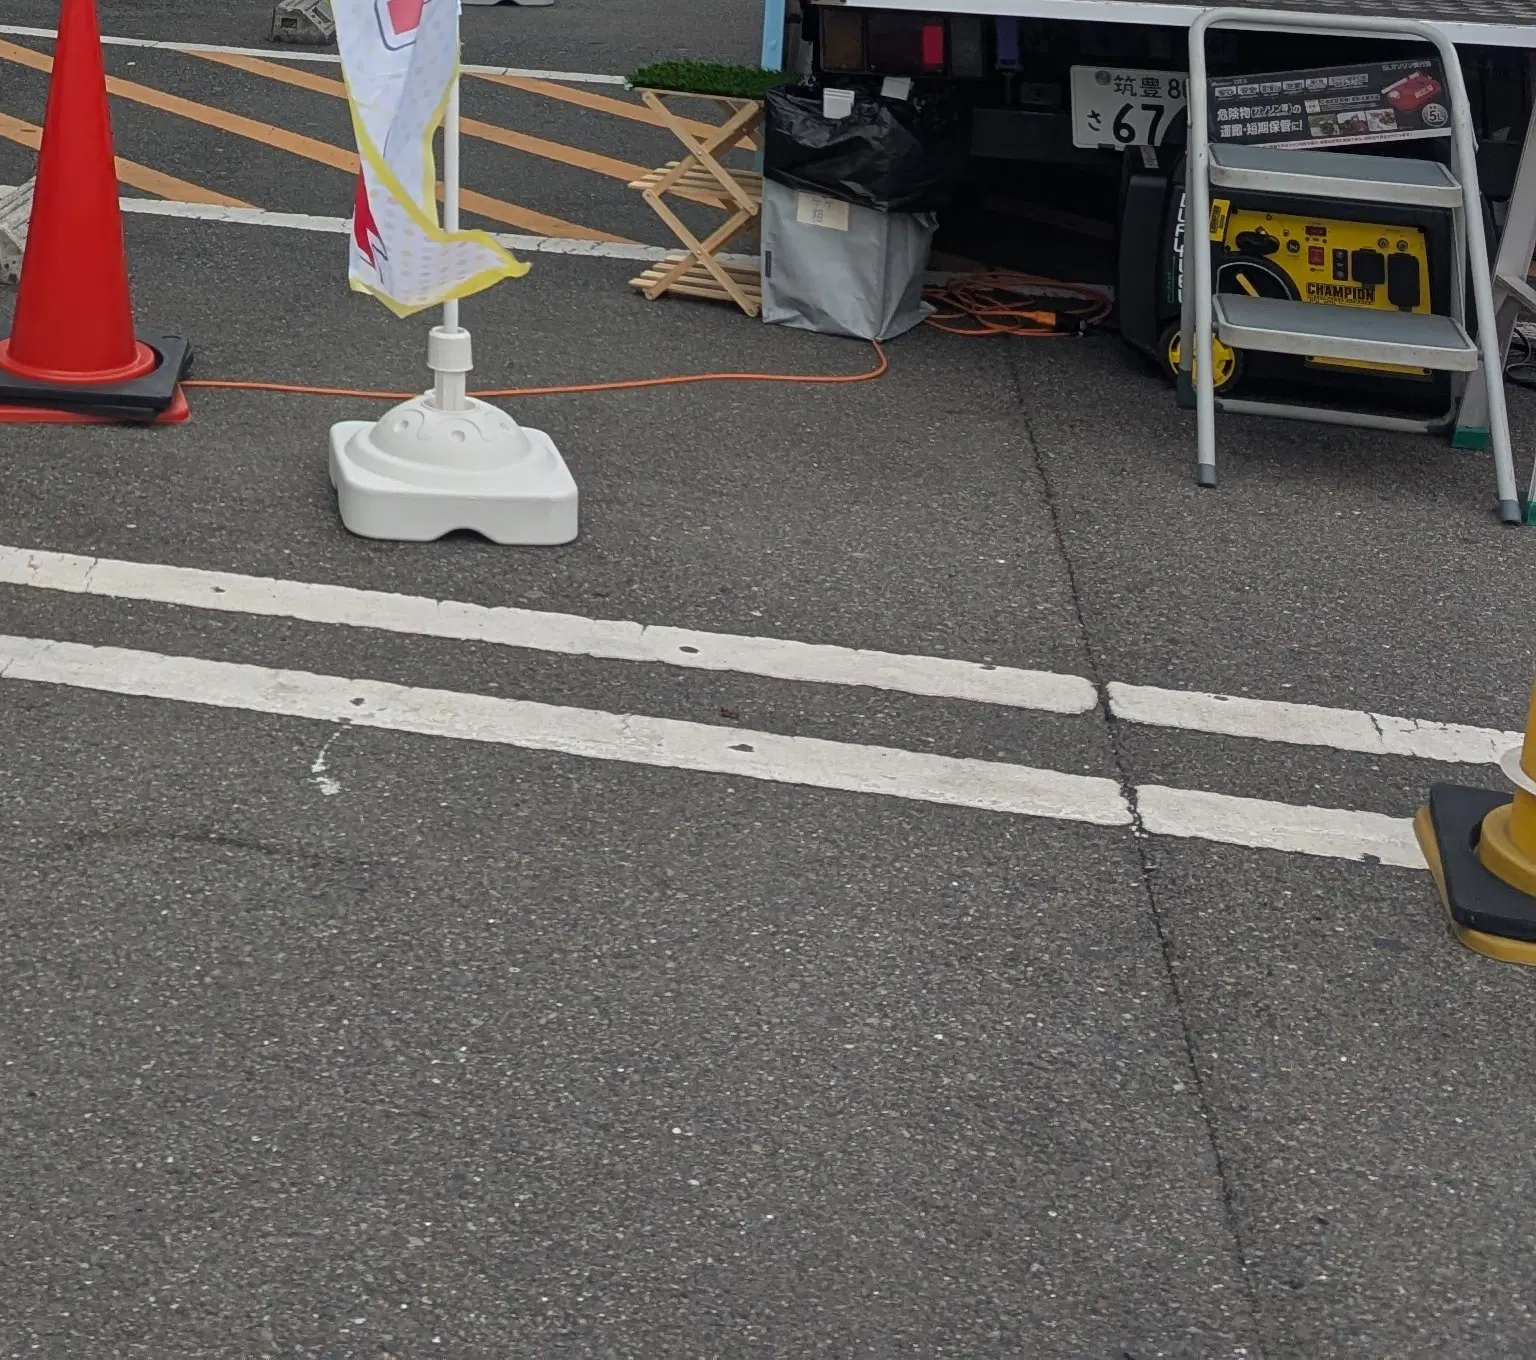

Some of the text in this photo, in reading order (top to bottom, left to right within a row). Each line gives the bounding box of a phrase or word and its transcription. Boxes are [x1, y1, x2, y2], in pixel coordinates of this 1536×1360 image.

[1114, 75, 1162, 98] 筑豊
[1087, 109, 1102, 132] さ
[1428, 110, 1443, 123] 5L
[1307, 282, 1375, 301] CHAMPION
